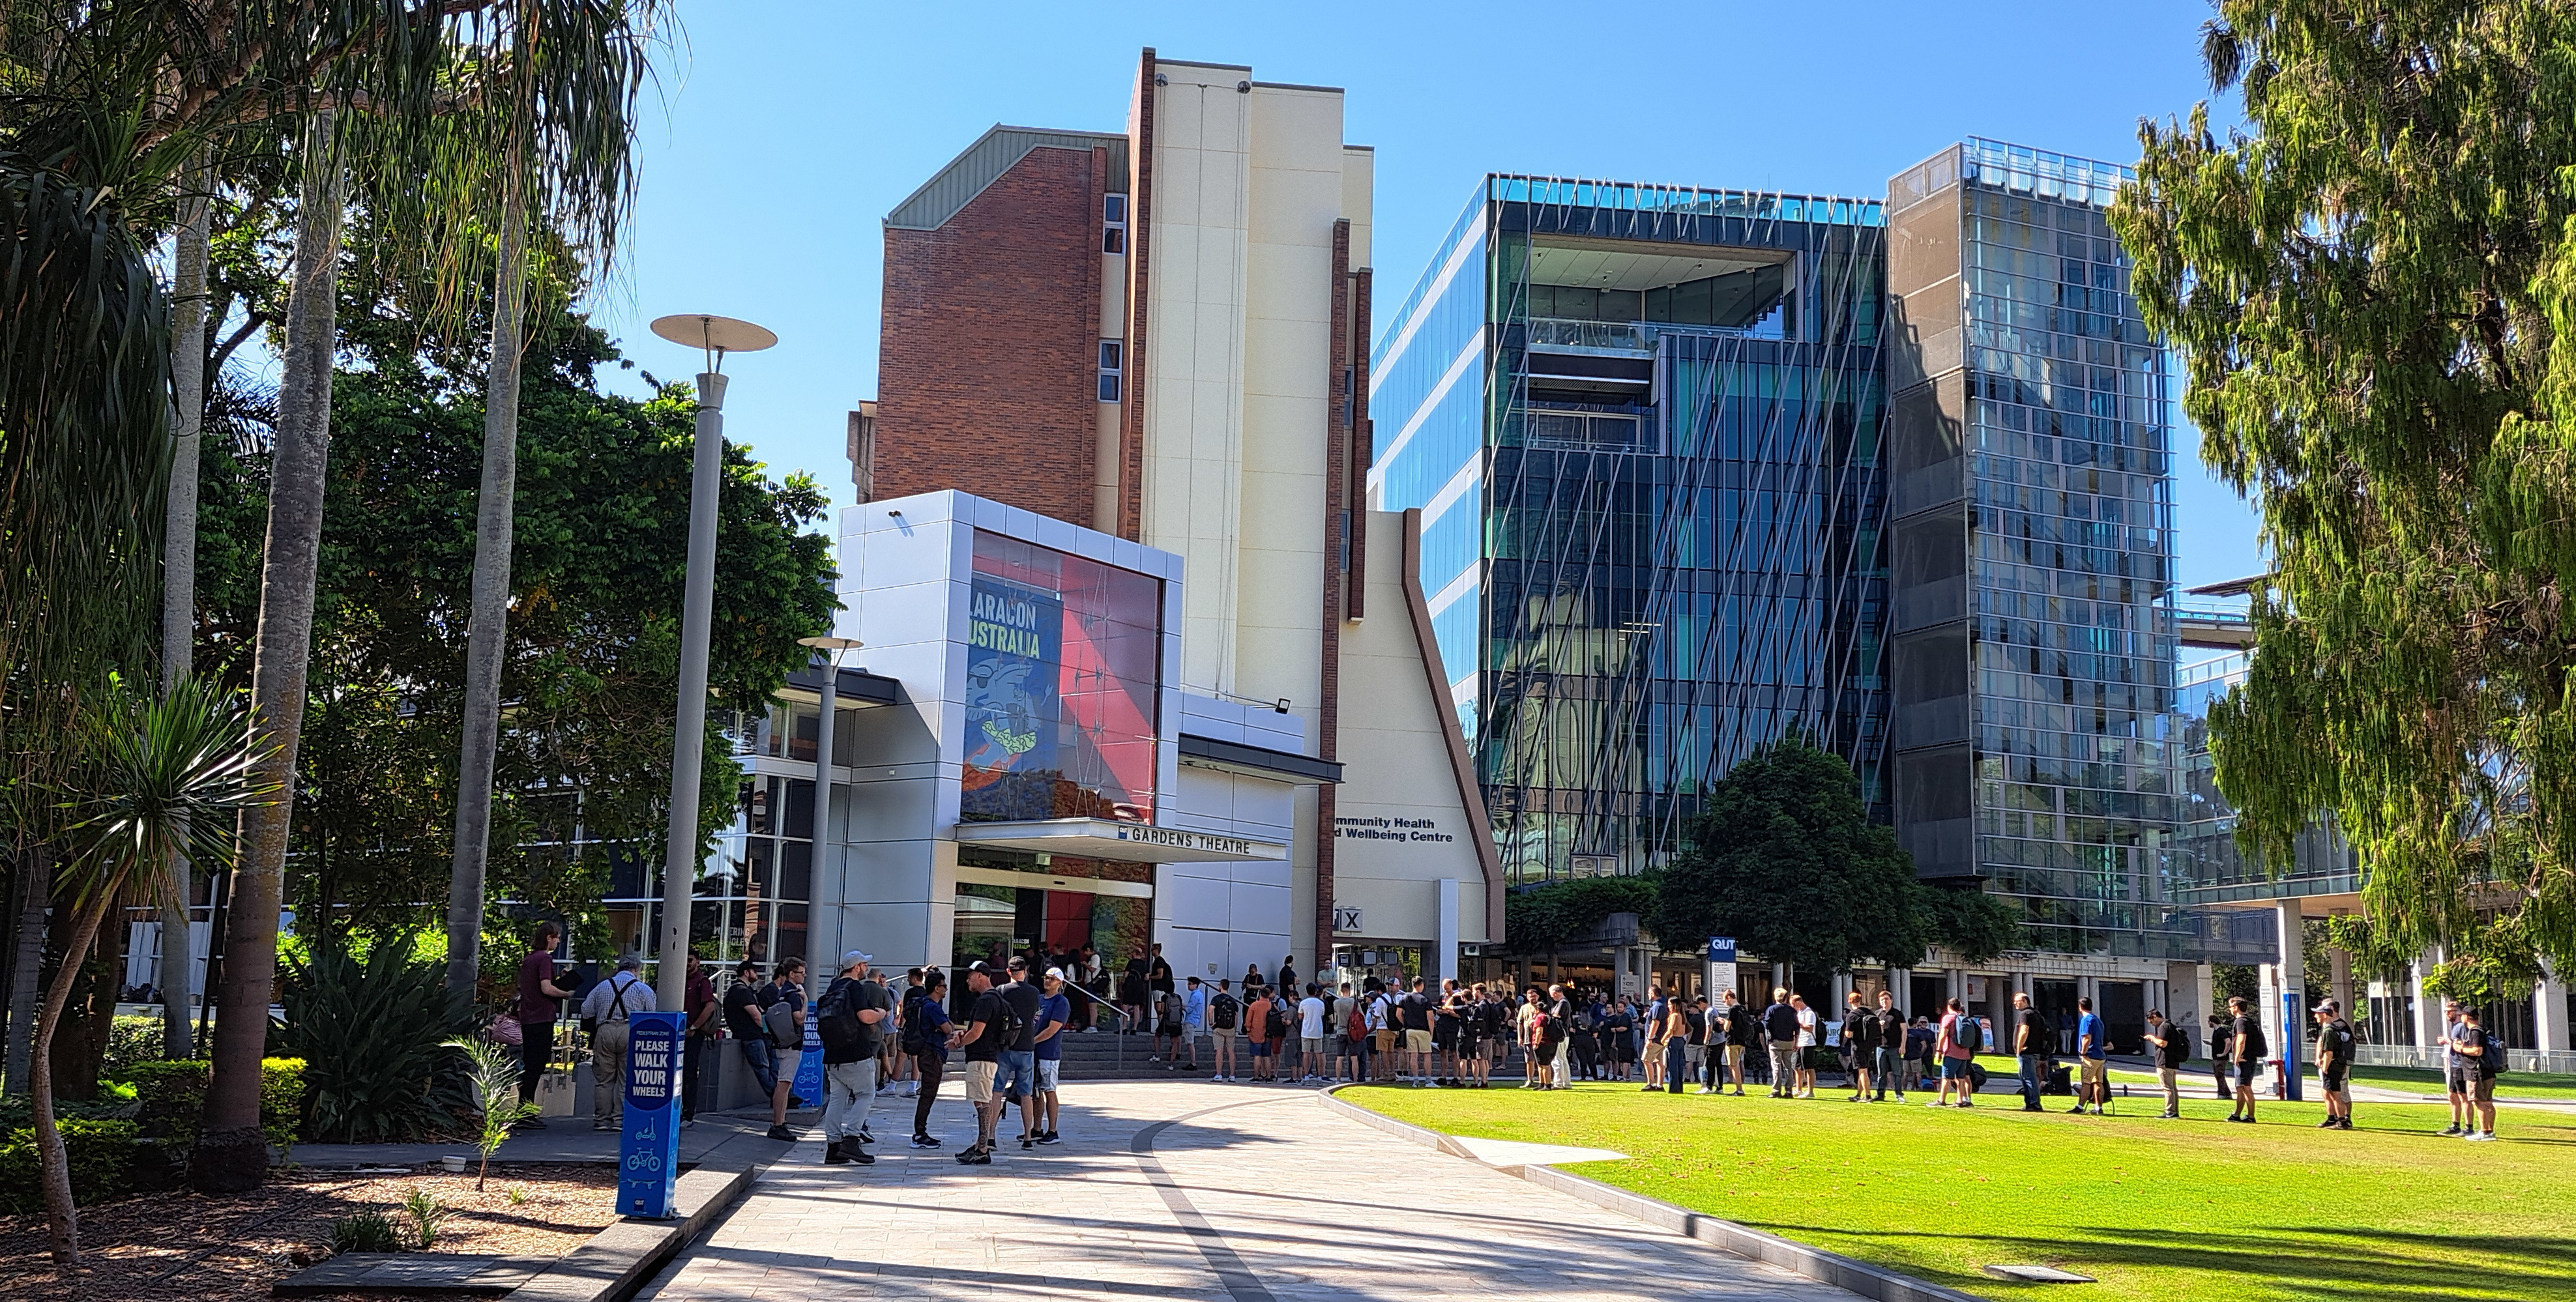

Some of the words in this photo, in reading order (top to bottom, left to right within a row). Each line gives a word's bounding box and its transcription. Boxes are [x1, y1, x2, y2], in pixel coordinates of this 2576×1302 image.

[970, 592, 1036, 631] ARACON
[1336, 817, 1391, 829] mmunity
[1394, 817, 1435, 829] Health
[1132, 828, 1193, 847] GARDENS
[1198, 836, 1251, 855] THEATRE
[1345, 828, 1407, 843] Wellbeing
[1410, 831, 1454, 843] Centre
[1345, 912, 1359, 929] X
[1712, 939, 1736, 950] QUT
[804, 1032, 821, 1040] OUR
[634, 1040, 670, 1052] PLEASE
[634, 1052, 669, 1068] WALK
[634, 1069, 666, 1086] YOUR
[632, 1086, 666, 1097] WHEELS
